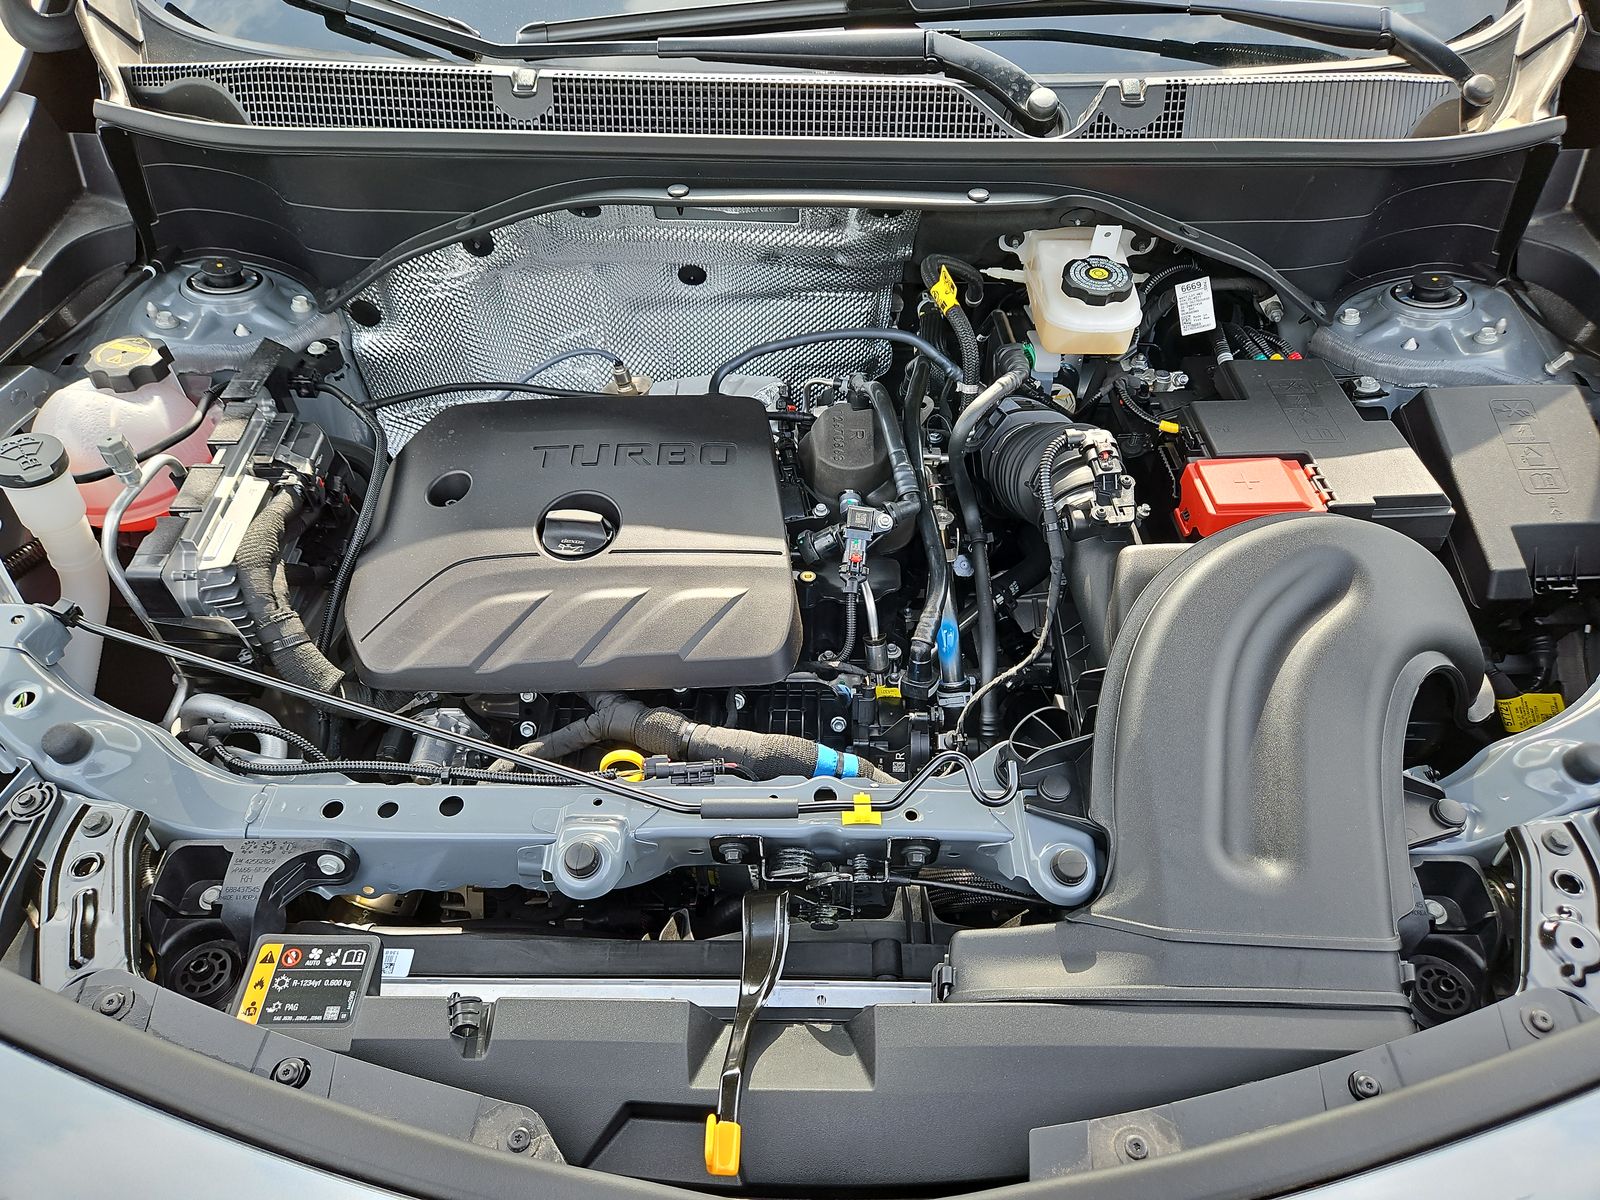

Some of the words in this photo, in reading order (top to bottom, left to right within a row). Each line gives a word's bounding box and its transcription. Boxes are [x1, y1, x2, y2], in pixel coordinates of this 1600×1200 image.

[1181, 281, 1202, 292] 6669
[849, 428, 866, 440] R
[532, 440, 738, 468] TURBO
[895, 752, 905, 760] R
[240, 875, 253, 883] RH
[292, 979, 322, 988] R-1234yf
[324, 979, 342, 987] 0.600
[342, 979, 352, 988] kg
[284, 1003, 299, 1011] PAG
